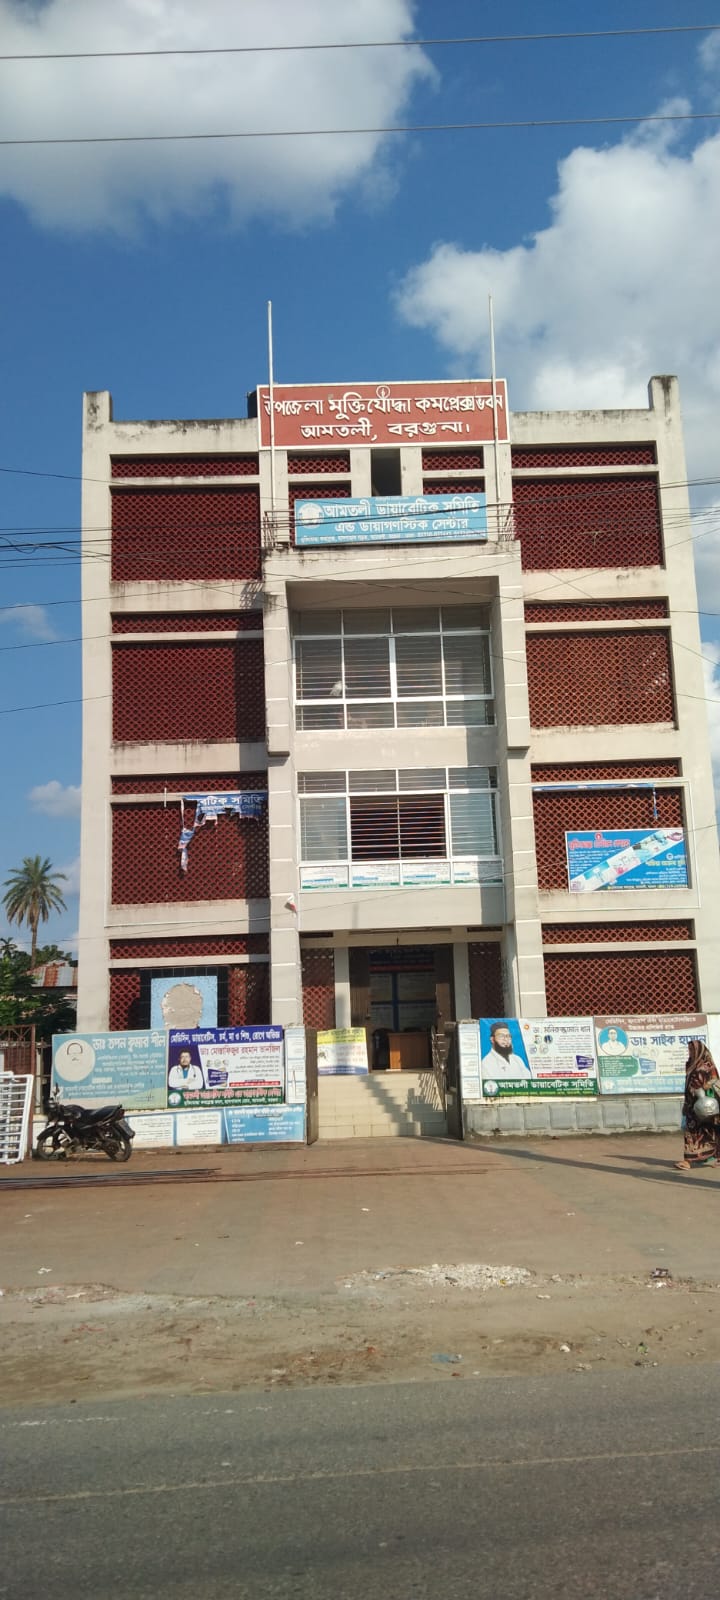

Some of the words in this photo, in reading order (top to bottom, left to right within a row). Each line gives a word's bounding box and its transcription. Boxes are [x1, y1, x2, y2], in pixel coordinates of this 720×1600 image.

[262, 394, 323, 415] উপজেলা
[301, 417, 377, 441] আমতলী,
[323, 499, 371, 519] আমতলী
[630, 1036, 647, 1046] ডাঃ
